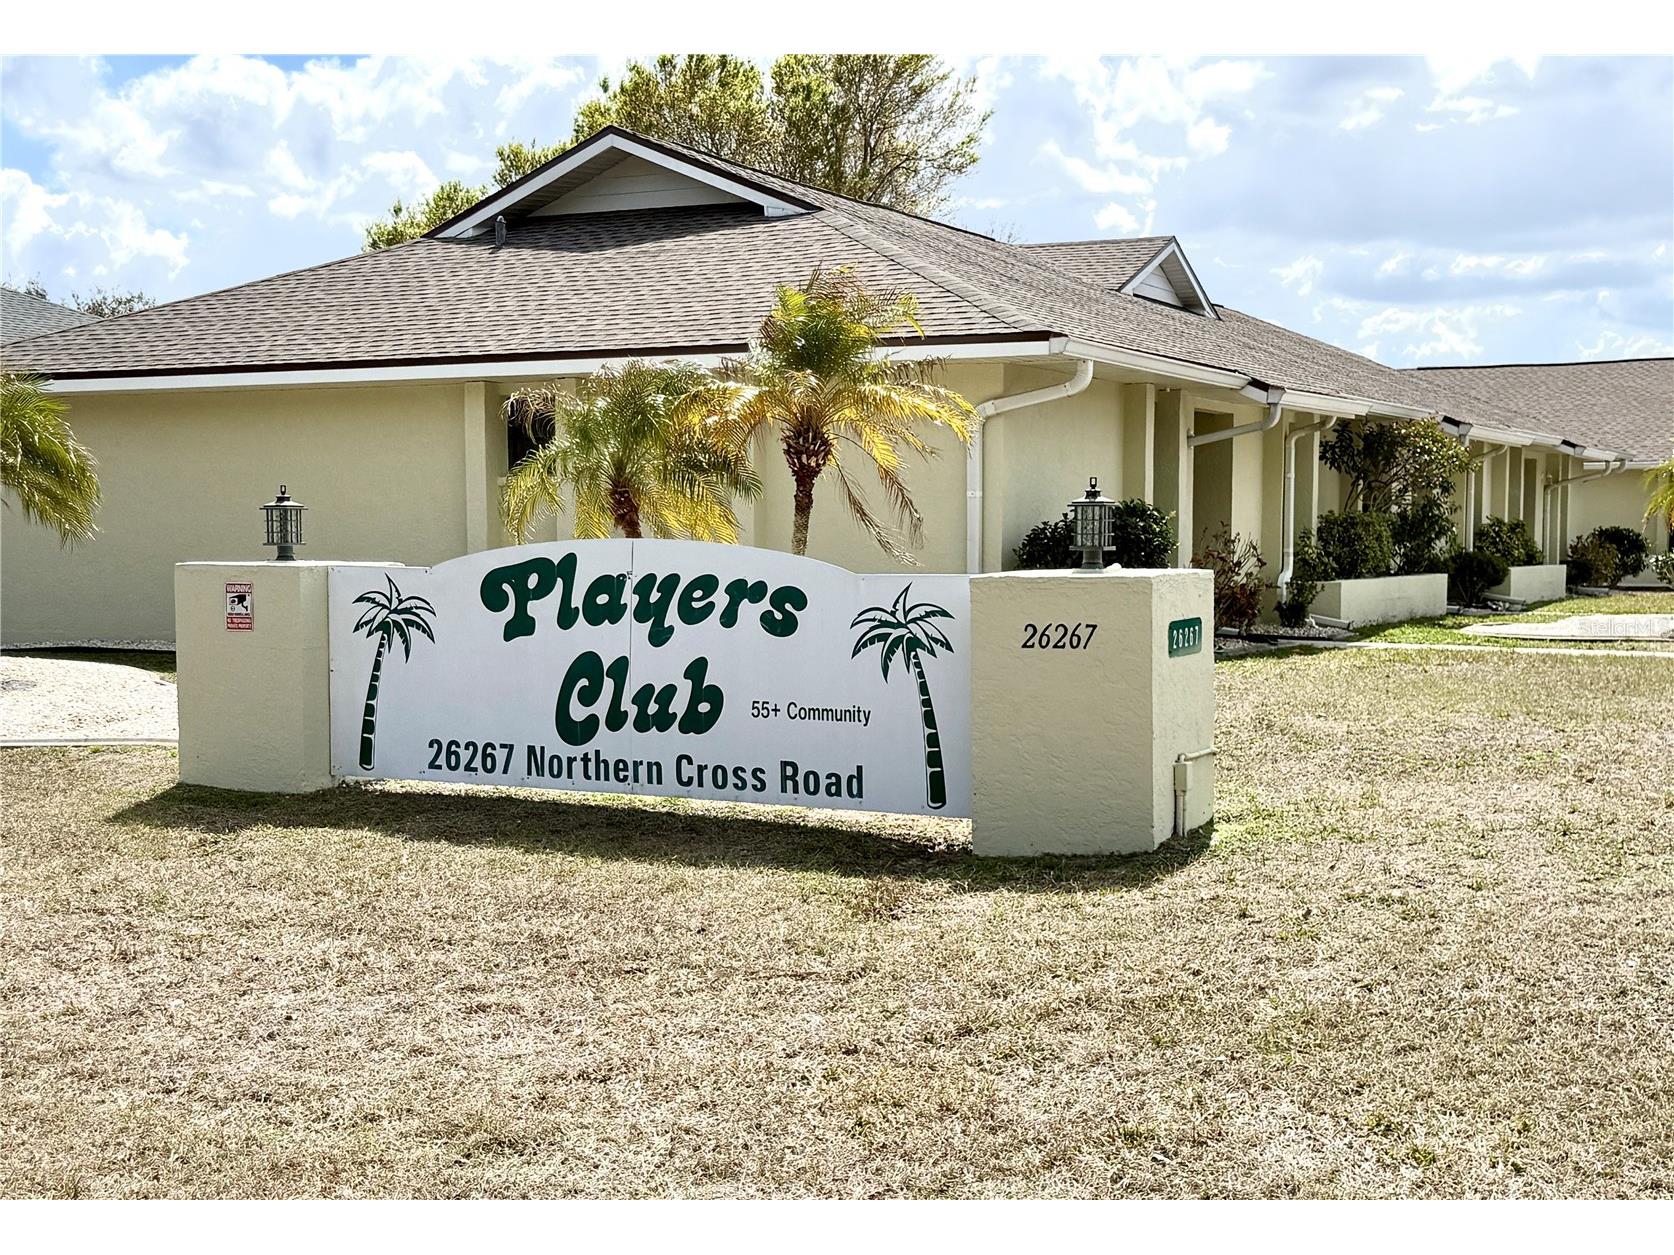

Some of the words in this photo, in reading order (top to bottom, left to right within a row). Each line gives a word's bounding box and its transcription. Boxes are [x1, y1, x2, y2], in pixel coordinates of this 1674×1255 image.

[480, 553, 808, 647] Players
[1021, 623, 1098, 649] 26267
[1172, 625, 1199, 649] 26267
[555, 651, 724, 746] Club
[751, 701, 780, 720] 55+
[787, 702, 872, 727] Community
[428, 739, 514, 775] 26267
[527, 745, 664, 786] Northern
[676, 754, 767, 793] Cross
[780, 761, 863, 800] Road
